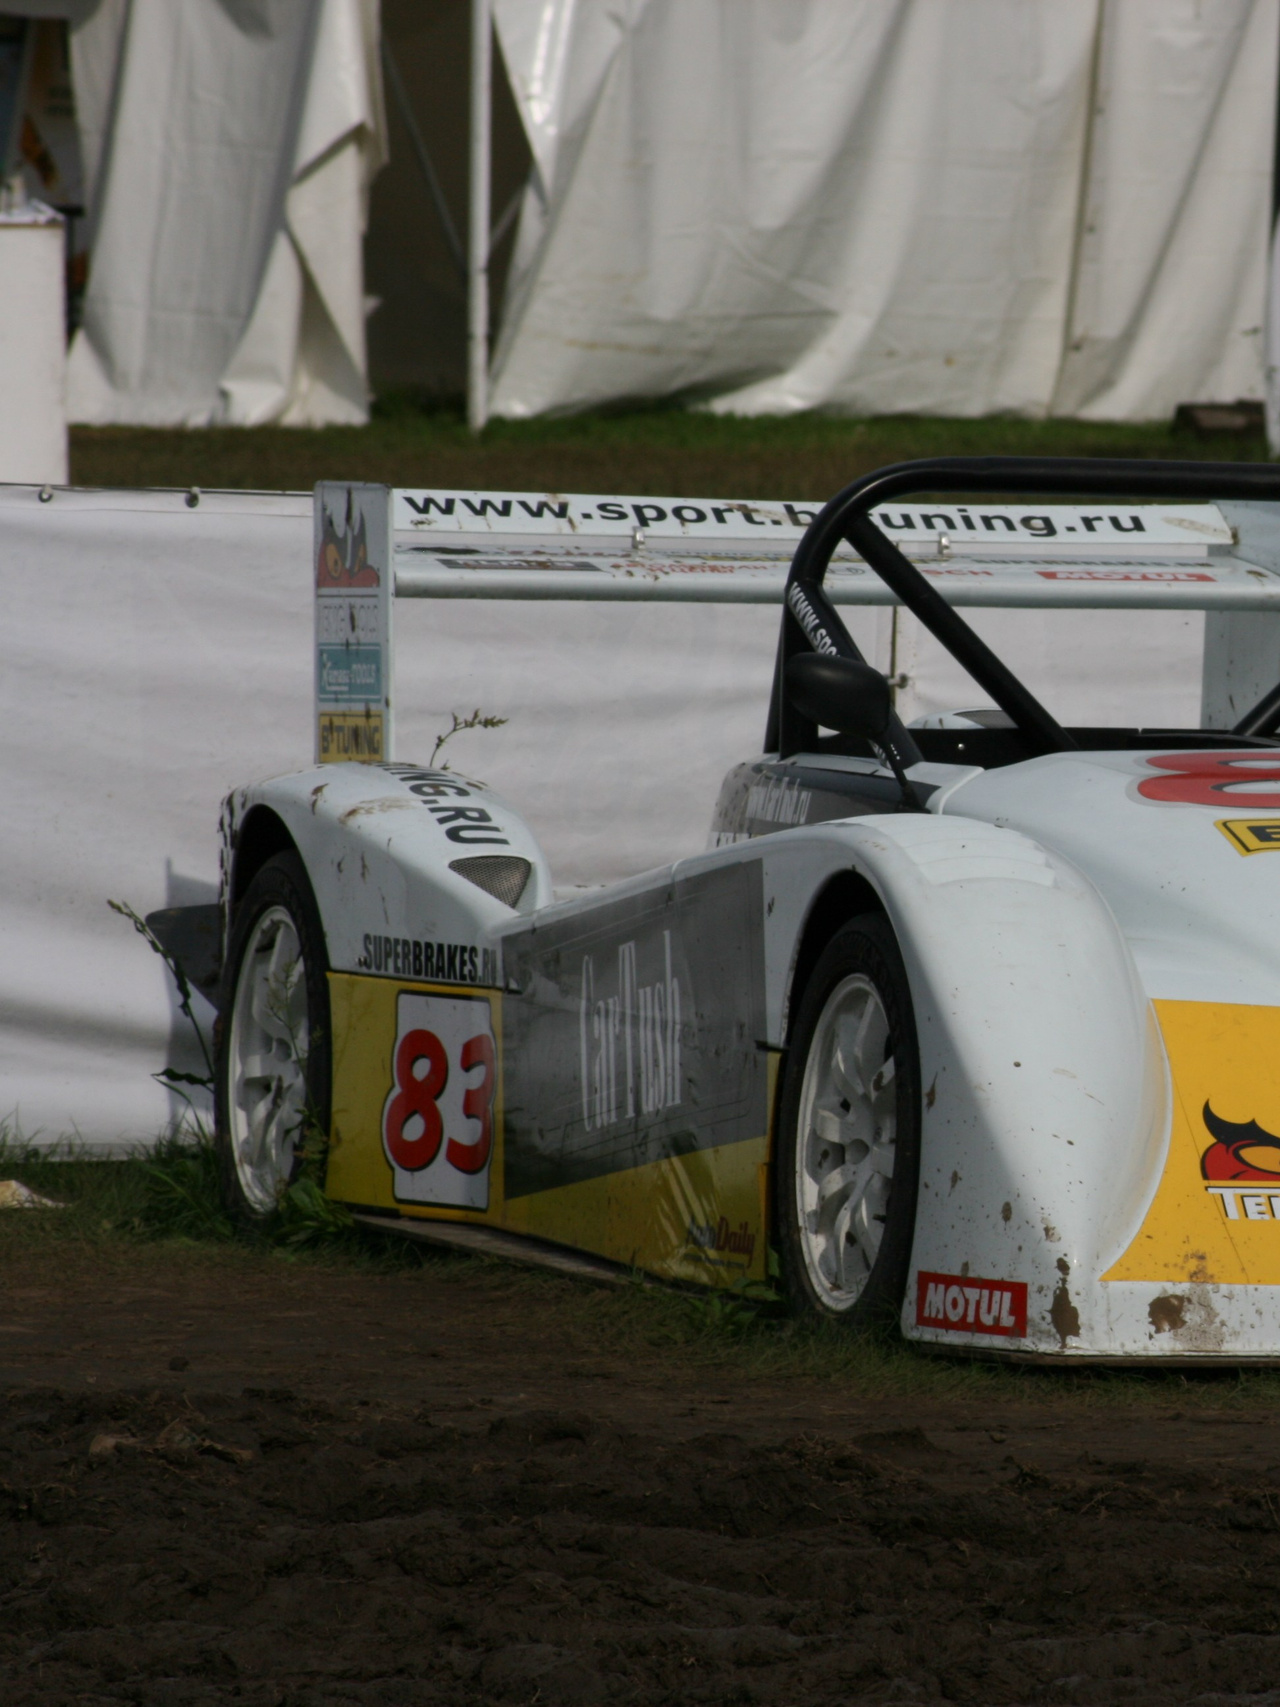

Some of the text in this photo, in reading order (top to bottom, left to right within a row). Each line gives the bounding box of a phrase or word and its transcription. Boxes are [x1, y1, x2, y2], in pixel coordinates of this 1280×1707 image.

[1056, 572, 1199, 581] MOTUL
[363, 932, 498, 985] SUPERBRAKES.RU
[384, 1028, 496, 1174] 83
[923, 1282, 1017, 1328] MOTUL
